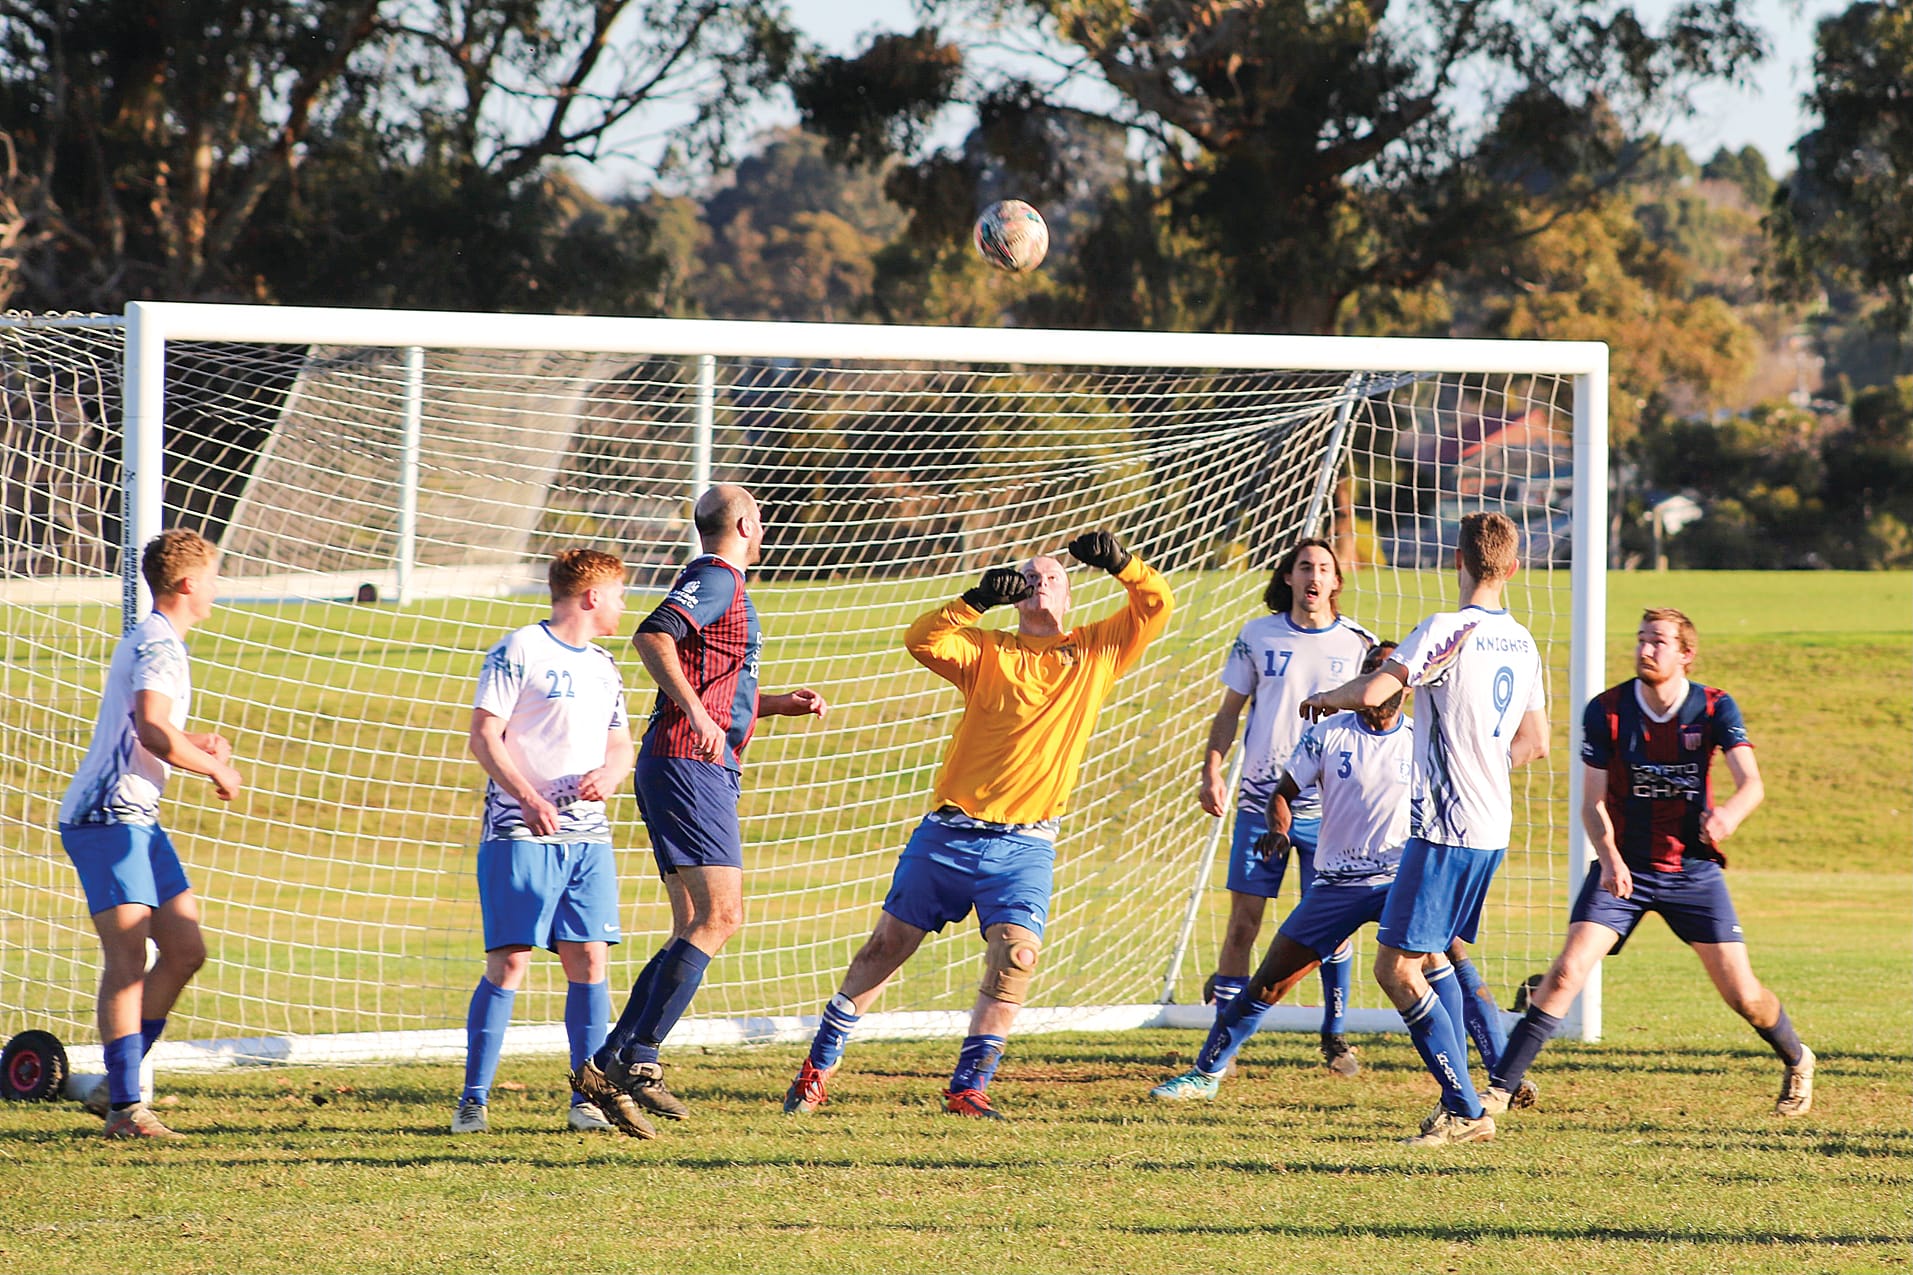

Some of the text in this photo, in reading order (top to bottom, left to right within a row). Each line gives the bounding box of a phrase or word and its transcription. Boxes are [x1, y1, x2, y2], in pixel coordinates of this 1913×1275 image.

[1475, 636, 1529, 653] KNIGHTS
[1263, 649, 1293, 677] 17
[545, 669, 575, 699] 22
[1492, 665, 1515, 738] 9
[1337, 751, 1353, 779] 3
